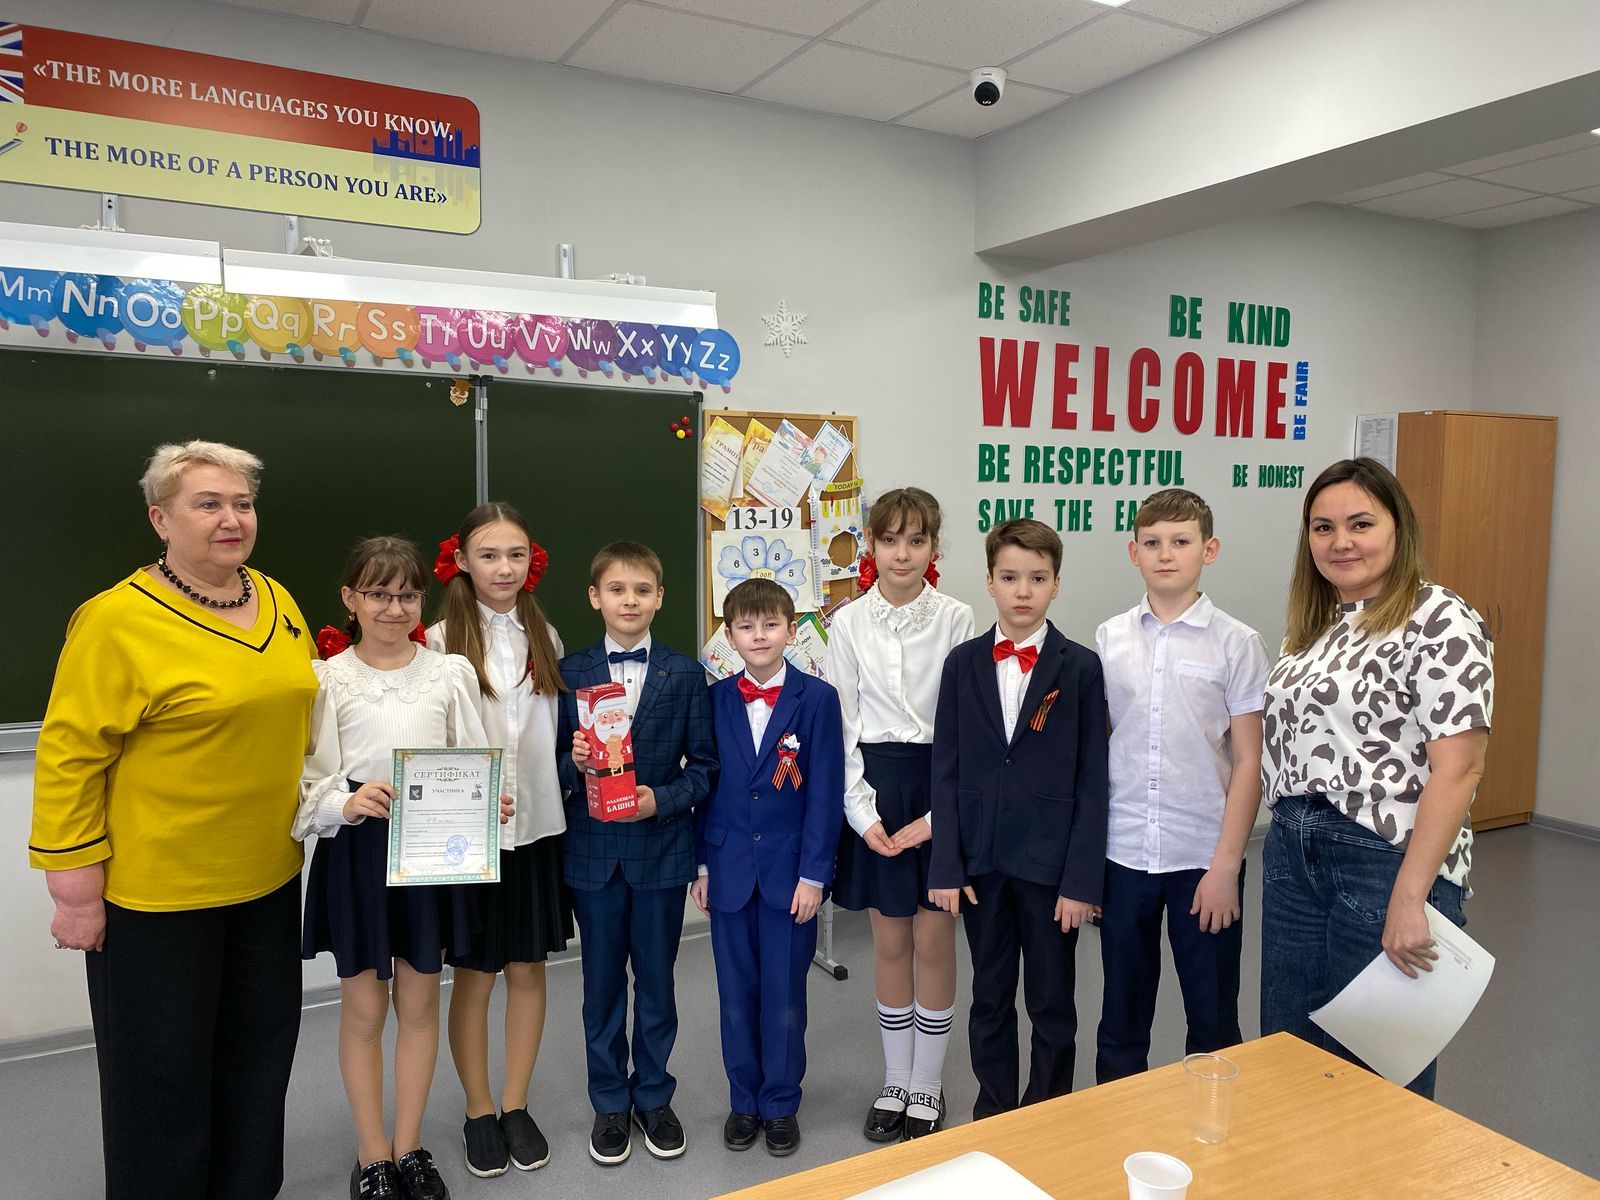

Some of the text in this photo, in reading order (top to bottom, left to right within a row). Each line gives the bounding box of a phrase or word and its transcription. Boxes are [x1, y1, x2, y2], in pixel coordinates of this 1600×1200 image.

[33, 60, 454, 143] «THE MORE LANGUAGES YOU KNOW,
[45, 136, 447, 205] THE MORE OF A PERSON YOU ARE»
[978, 282, 1071, 326] BE SAFE
[62, 280, 118, 318] Nn
[126, 292, 182, 328] Oo
[194, 299, 243, 338] Pp
[251, 300, 300, 337] Qq
[313, 304, 356, 341] Rr
[370, 308, 407, 342] Ss
[467, 319, 506, 350] Uu
[519, 322, 561, 353] Vv
[568, 326, 611, 355] Ww
[617, 330, 654, 358] Xx
[699, 341, 730, 372] Zz
[1168, 294, 1291, 348] BE KIND
[979, 336, 1288, 440] WELCOME
[1293, 361, 1309, 440] BE FAIR
[715, 439, 741, 460] ГРАМОТ
[978, 443, 1185, 486] BE RESPECTFUL
[1232, 464, 1305, 488] BE HONEST
[834, 482, 853, 490] TODAY
[733, 507, 793, 530] 13-19
[978, 498, 1035, 533] SAVE
[1055, 499, 1093, 532] THE
[733, 560, 740, 568] 6
[752, 548, 760, 557] 3
[774, 552, 781, 562] 8
[788, 569, 795, 578] 5
[413, 771, 481, 779] СЕРТИФИКАТ
[607, 800, 635, 813] БАШНЯ
